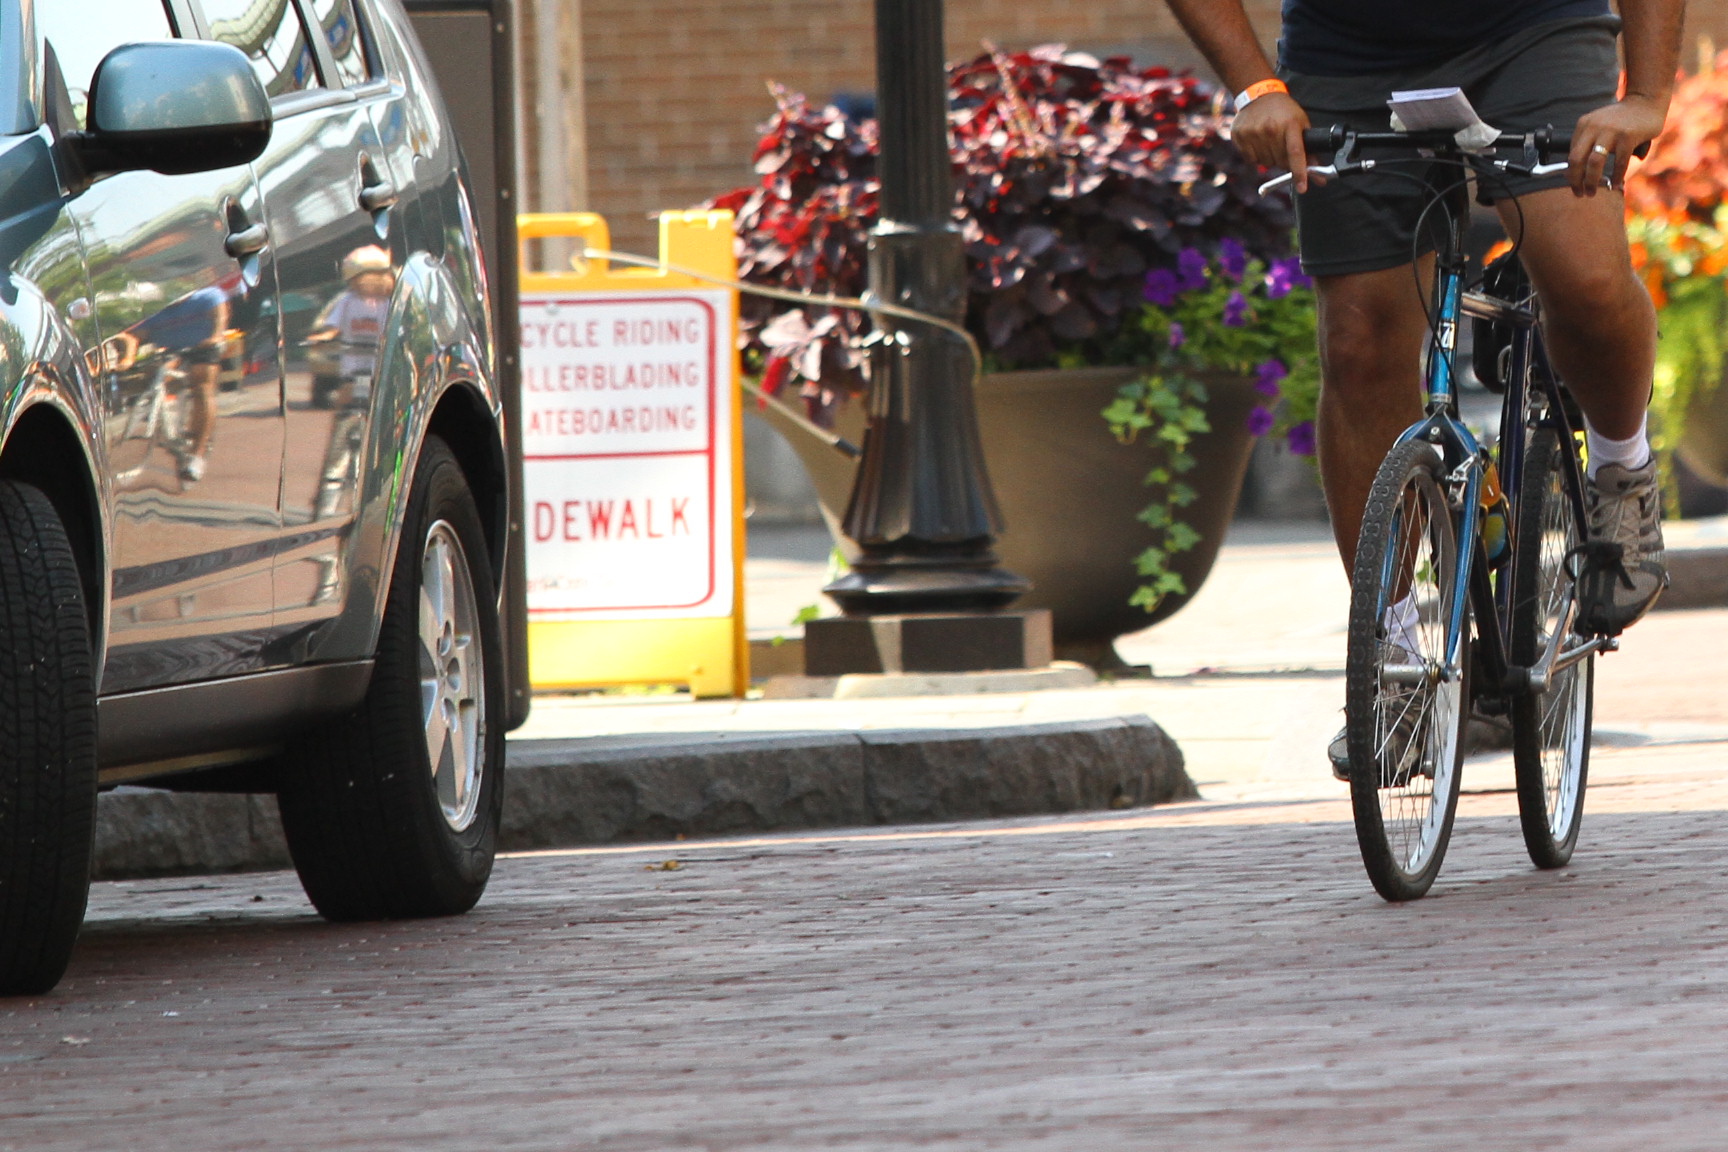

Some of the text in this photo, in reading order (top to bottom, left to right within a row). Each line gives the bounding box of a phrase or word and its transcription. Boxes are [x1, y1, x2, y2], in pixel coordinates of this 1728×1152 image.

[520, 318, 700, 348] CYCLE RIDING
[526, 362, 699, 392] LLERBLADING
[529, 405, 696, 435] ATEBOARDING
[534, 496, 691, 543] DEWALK
